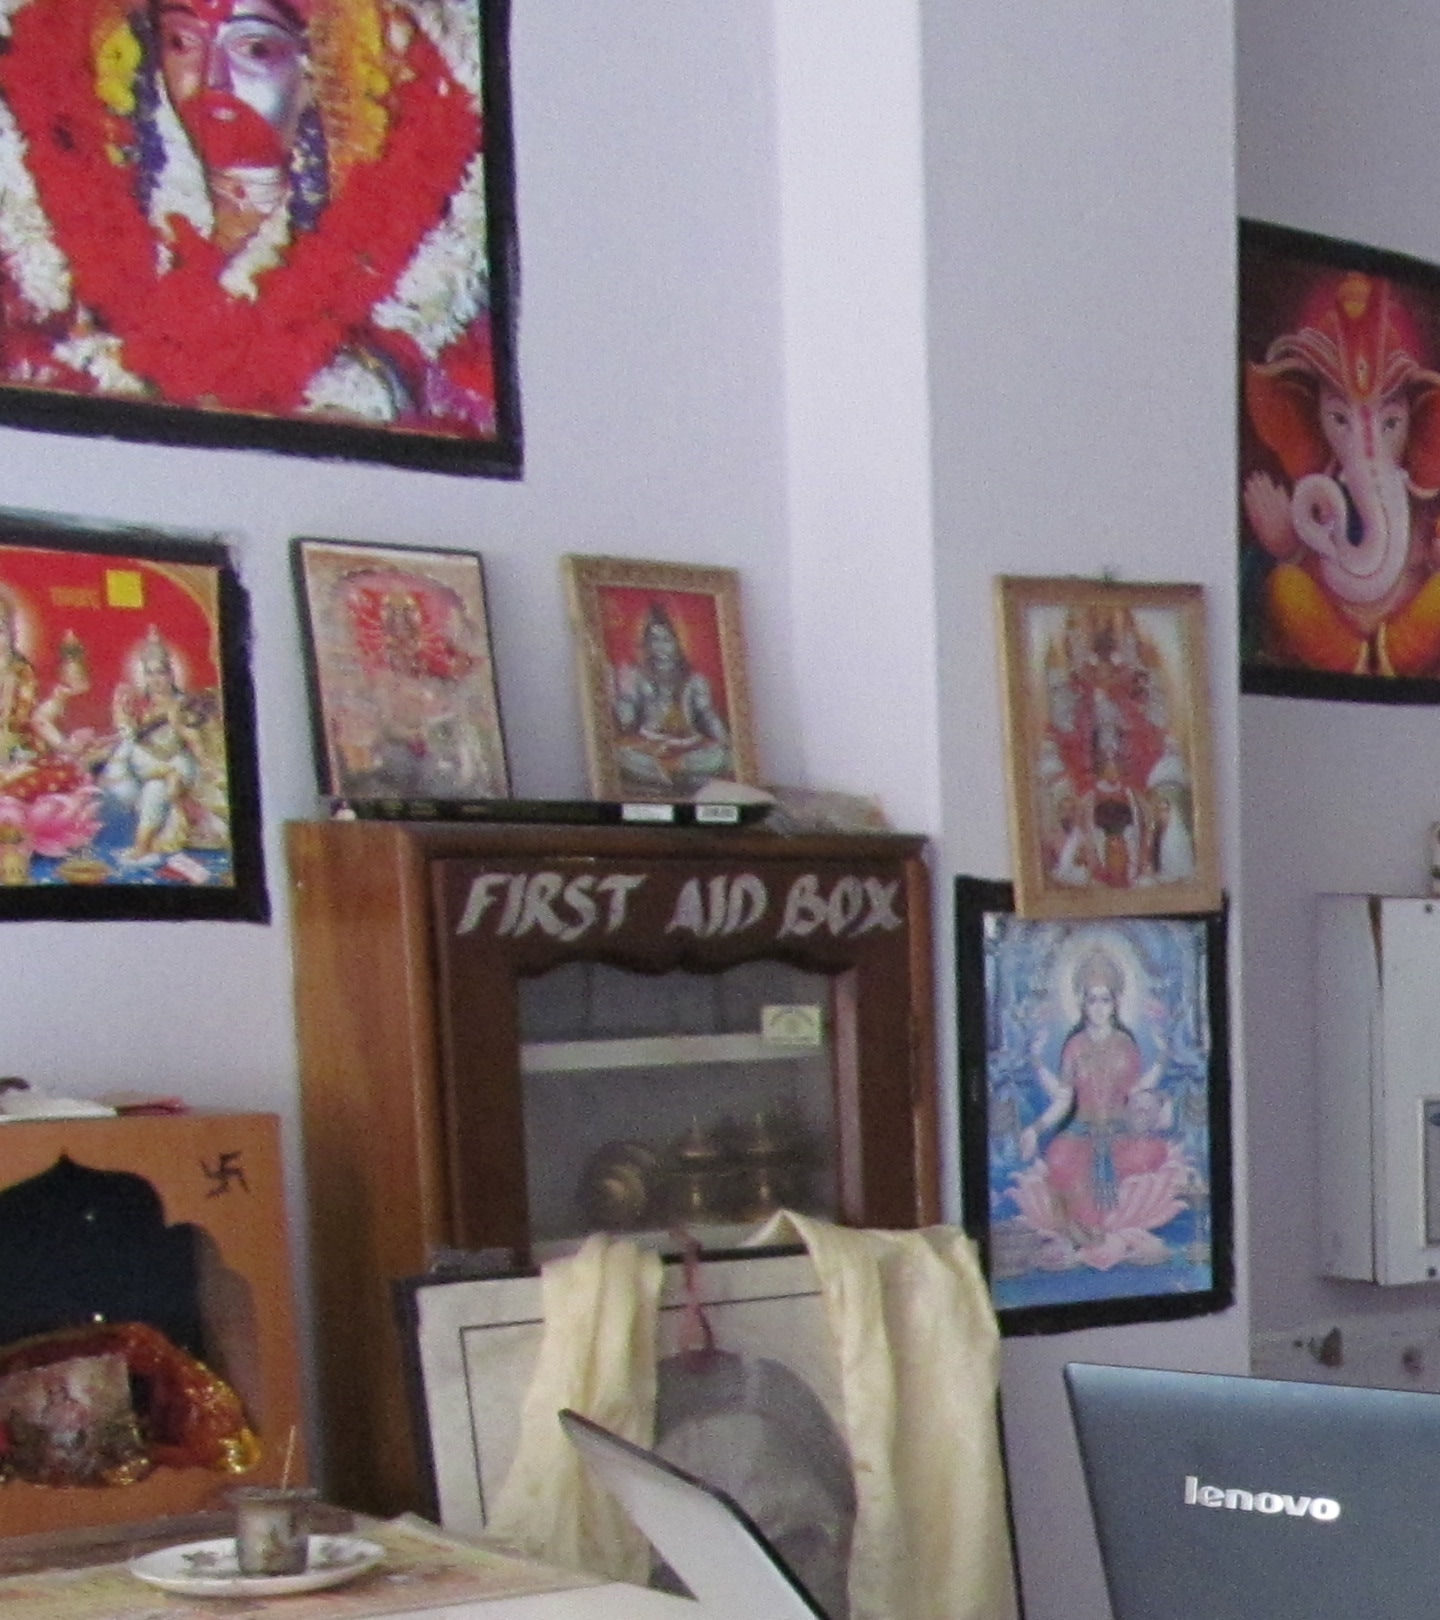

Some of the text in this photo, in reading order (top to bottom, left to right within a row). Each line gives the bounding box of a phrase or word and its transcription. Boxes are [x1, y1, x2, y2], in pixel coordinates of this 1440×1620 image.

[455, 872, 902, 942] FIRST AID BOX
[1184, 1475, 1341, 1521] lenovo
